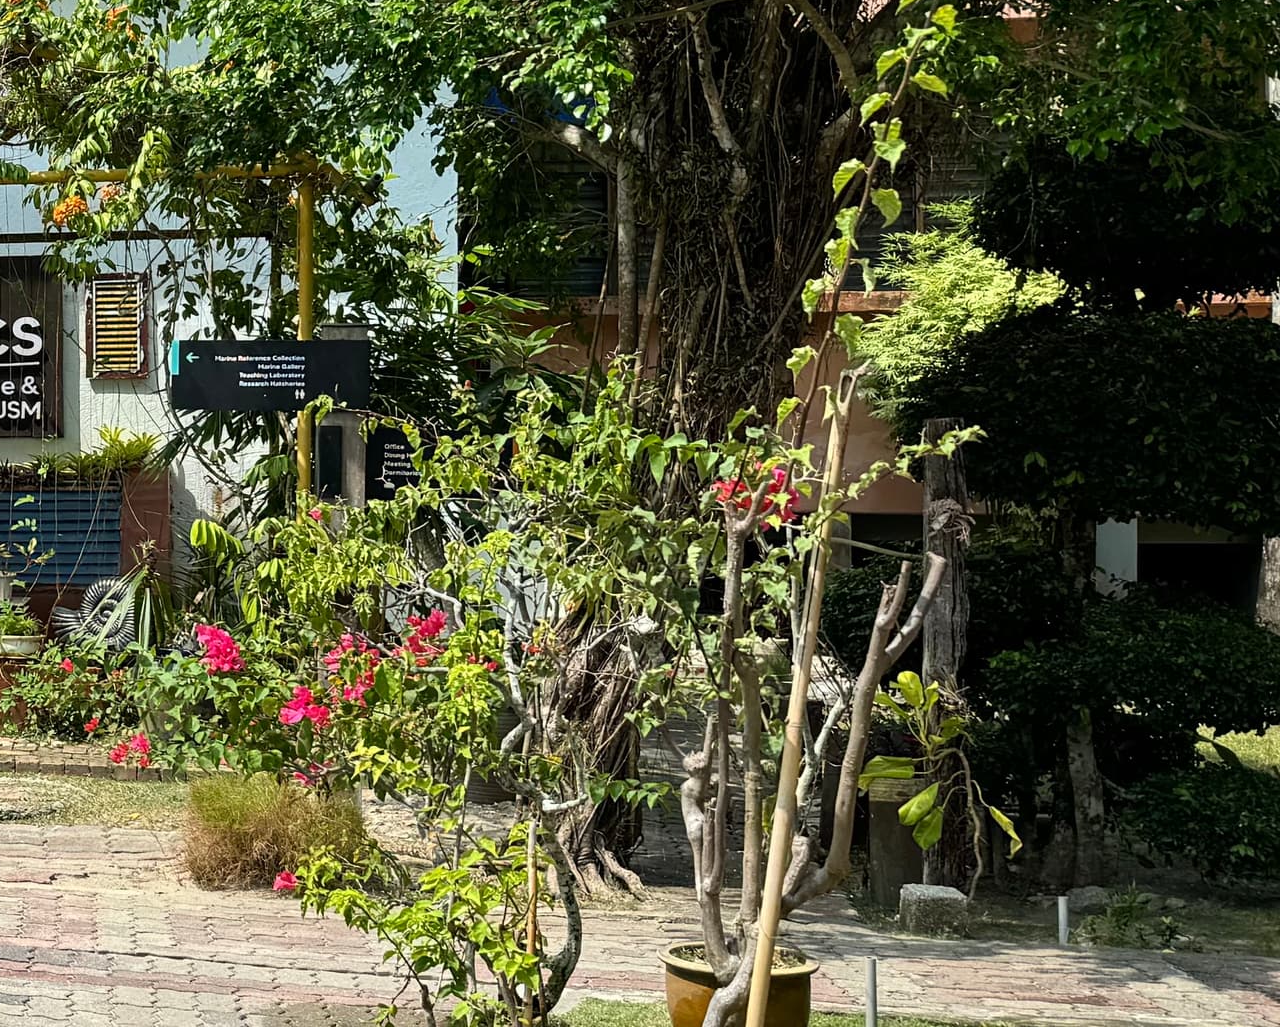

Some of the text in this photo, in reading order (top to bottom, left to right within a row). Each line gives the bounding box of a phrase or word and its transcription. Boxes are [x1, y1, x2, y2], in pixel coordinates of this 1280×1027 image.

[281, 363, 305, 371] Gallery
[21, 376, 40, 396] &
[384, 461, 412, 469] Meeting
